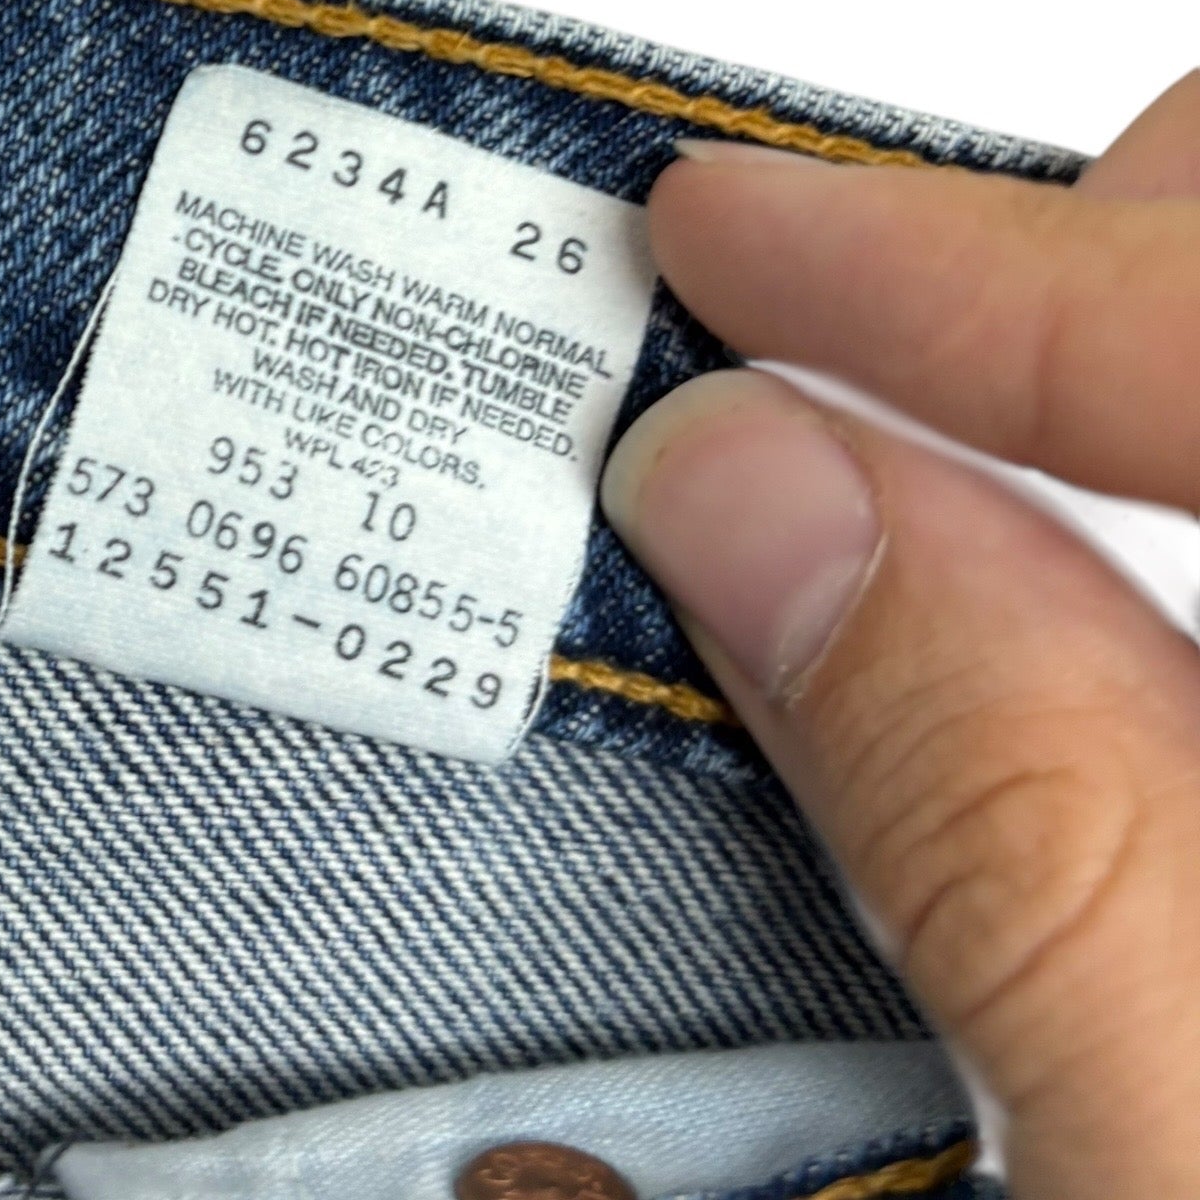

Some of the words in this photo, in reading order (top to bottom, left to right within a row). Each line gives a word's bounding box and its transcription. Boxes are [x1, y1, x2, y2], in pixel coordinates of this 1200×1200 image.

[240, 119, 450, 219] 6234A
[509, 221, 589, 274] 26
[175, 189, 306, 258] MACHINE
[312, 241, 395, 292] WASH
[402, 275, 489, 328] WARM
[492, 311, 612, 379] NORMAL
[178, 257, 294, 318] BLEACH
[295, 300, 327, 327] IF
[328, 313, 453, 380] NEEDED.
[460, 358, 573, 425] TUMBLE
[291, 268, 371, 313] ONLY
[370, 296, 588, 400] NON-CHLORINE
[148, 278, 211, 317] DRY
[212, 302, 281, 346] HOT.
[284, 327, 350, 370] HOT
[353, 352, 424, 400] IRON
[430, 382, 459, 408] IF
[460, 395, 578, 462] NEEDED.
[213, 367, 287, 413] WITH
[292, 397, 357, 439] LIKE
[360, 423, 486, 489] COLORS.
[252, 346, 339, 398] WASH
[339, 383, 402, 422] AND
[407, 408, 468, 445] DRY
[206, 436, 298, 499] 953
[361, 490, 416, 542] 10
[284, 426, 343, 470] WPL
[48, 521, 502, 710] 12551-0229
[66, 456, 157, 518] 573
[184, 498, 309, 575] 0696
[335, 553, 523, 648] 60855-5
